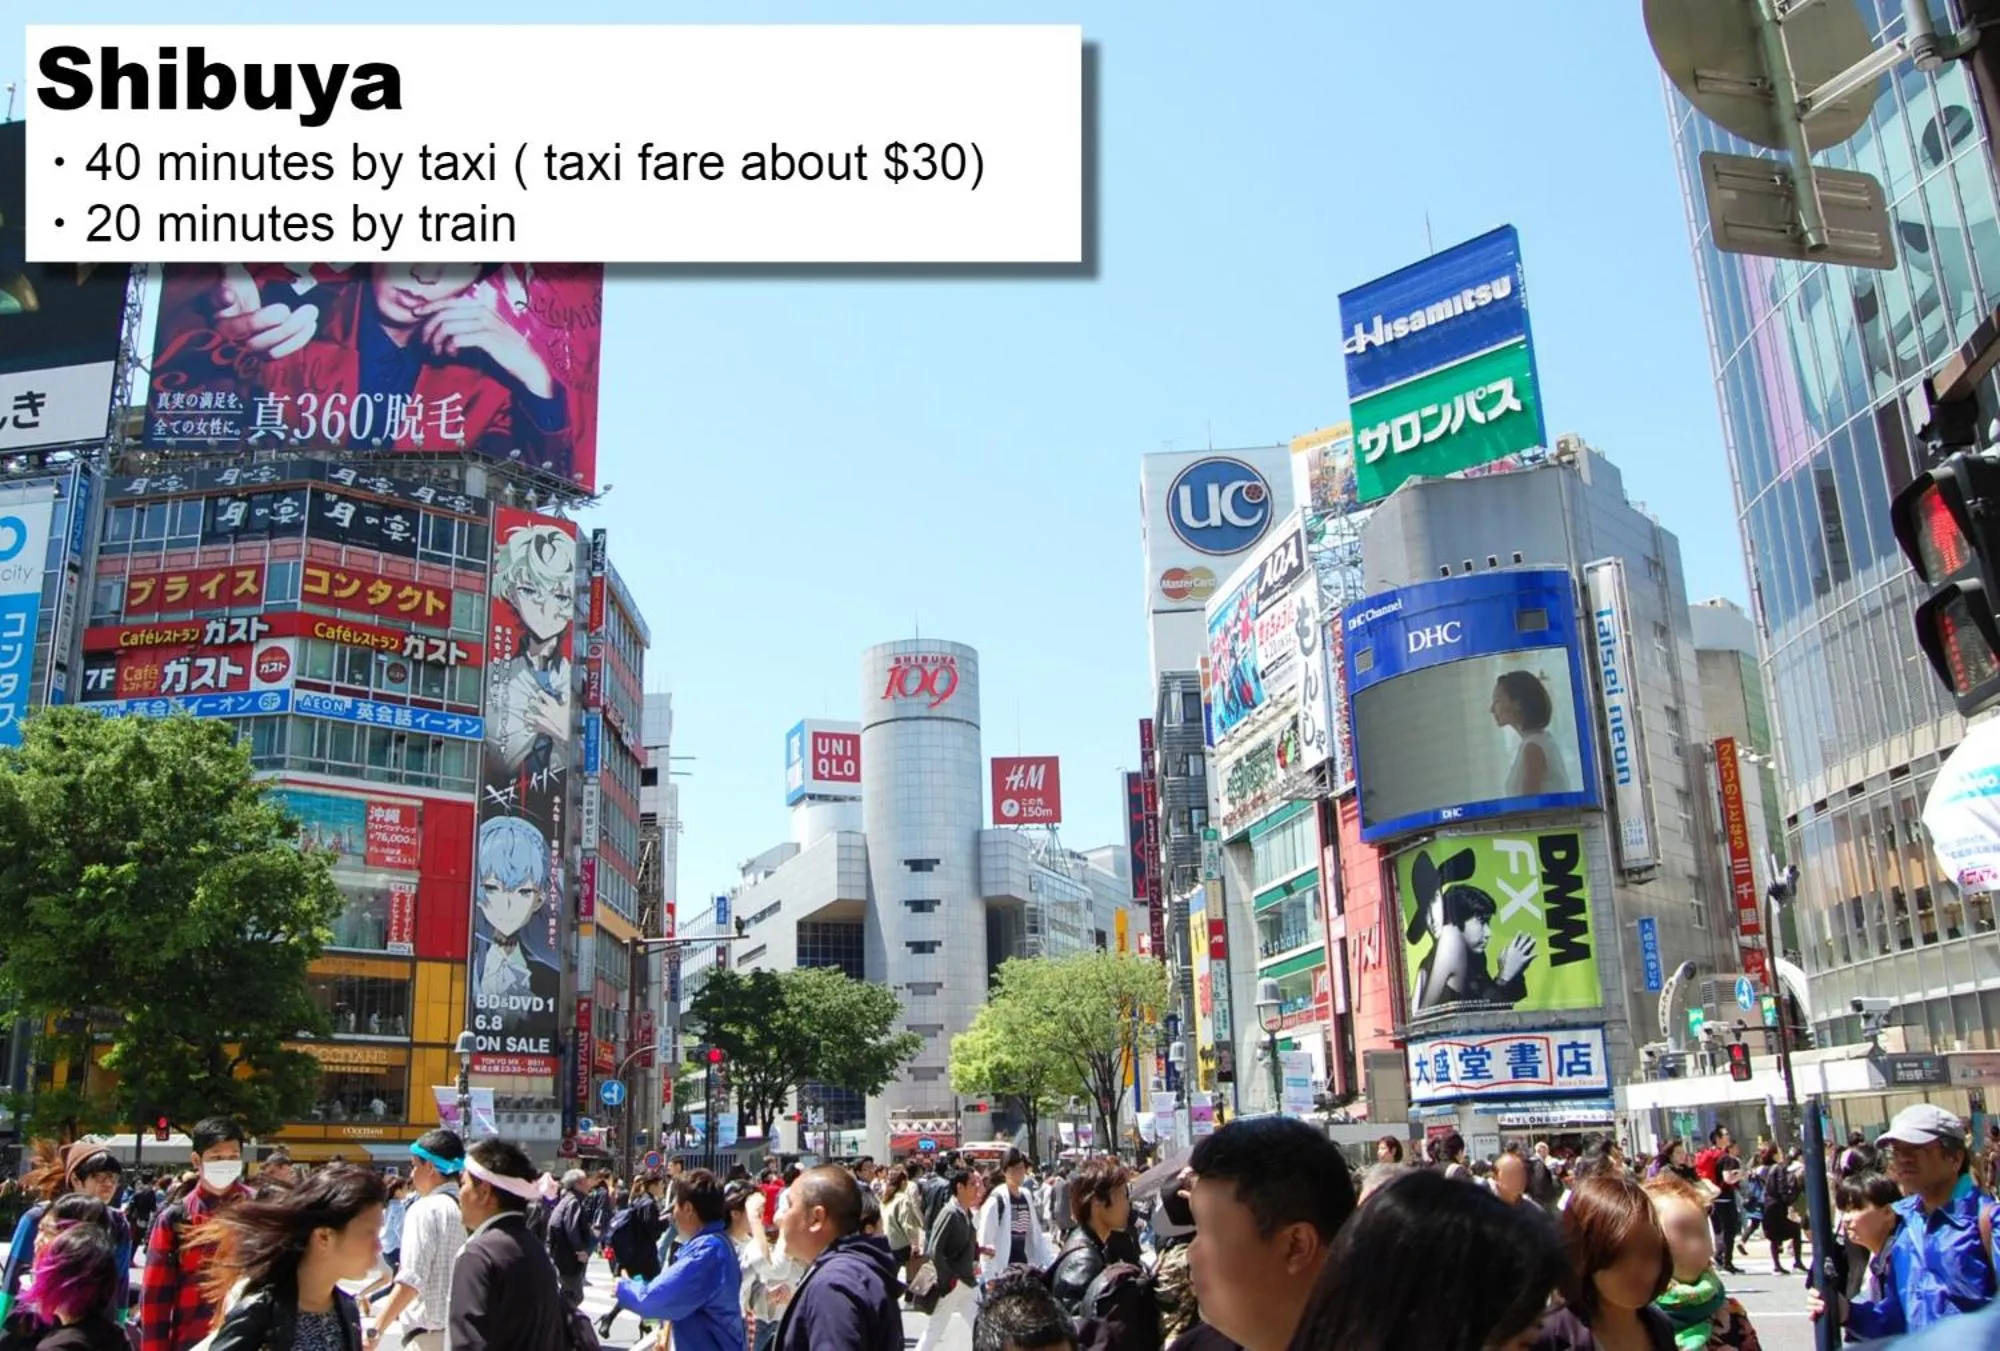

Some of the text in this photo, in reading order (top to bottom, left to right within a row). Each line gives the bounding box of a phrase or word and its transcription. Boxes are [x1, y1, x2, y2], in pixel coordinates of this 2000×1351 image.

[1342, 276, 1512, 353] Hisamitsu
[1358, 377, 1522, 464] サロンパス
[128, 568, 259, 605] プライス
[304, 566, 447, 617] コンタクト
[203, 616, 269, 645] ガスト
[1348, 599, 1402, 631] DHC Channel
[402, 632, 470, 667] ガスト
[1408, 621, 1461, 653] DHC
[123, 665, 159, 682] Café
[160, 656, 243, 693] ガスト
[893, 655, 957, 666] SHIBUYA
[86, 667, 116, 690] 7F
[881, 664, 960, 710] 109
[301, 695, 480, 735] AEON 英会話イーオン
[817, 738, 852, 756] UNI
[1608, 705, 1631, 785] neon
[817, 759, 856, 779] QLO
[1004, 764, 1046, 791] H&M
[1022, 806, 1053, 817] 150m
[1719, 742, 1746, 849] クスリのことなら
[1493, 839, 1542, 924] FX
[1538, 833, 1592, 967] DMM
[475, 1014, 503, 1030] 6.8
[547, 998, 555, 1013] 1
[476, 1035, 550, 1053] ON SALE
[1414, 1041, 1593, 1086] 大盛堂書店
